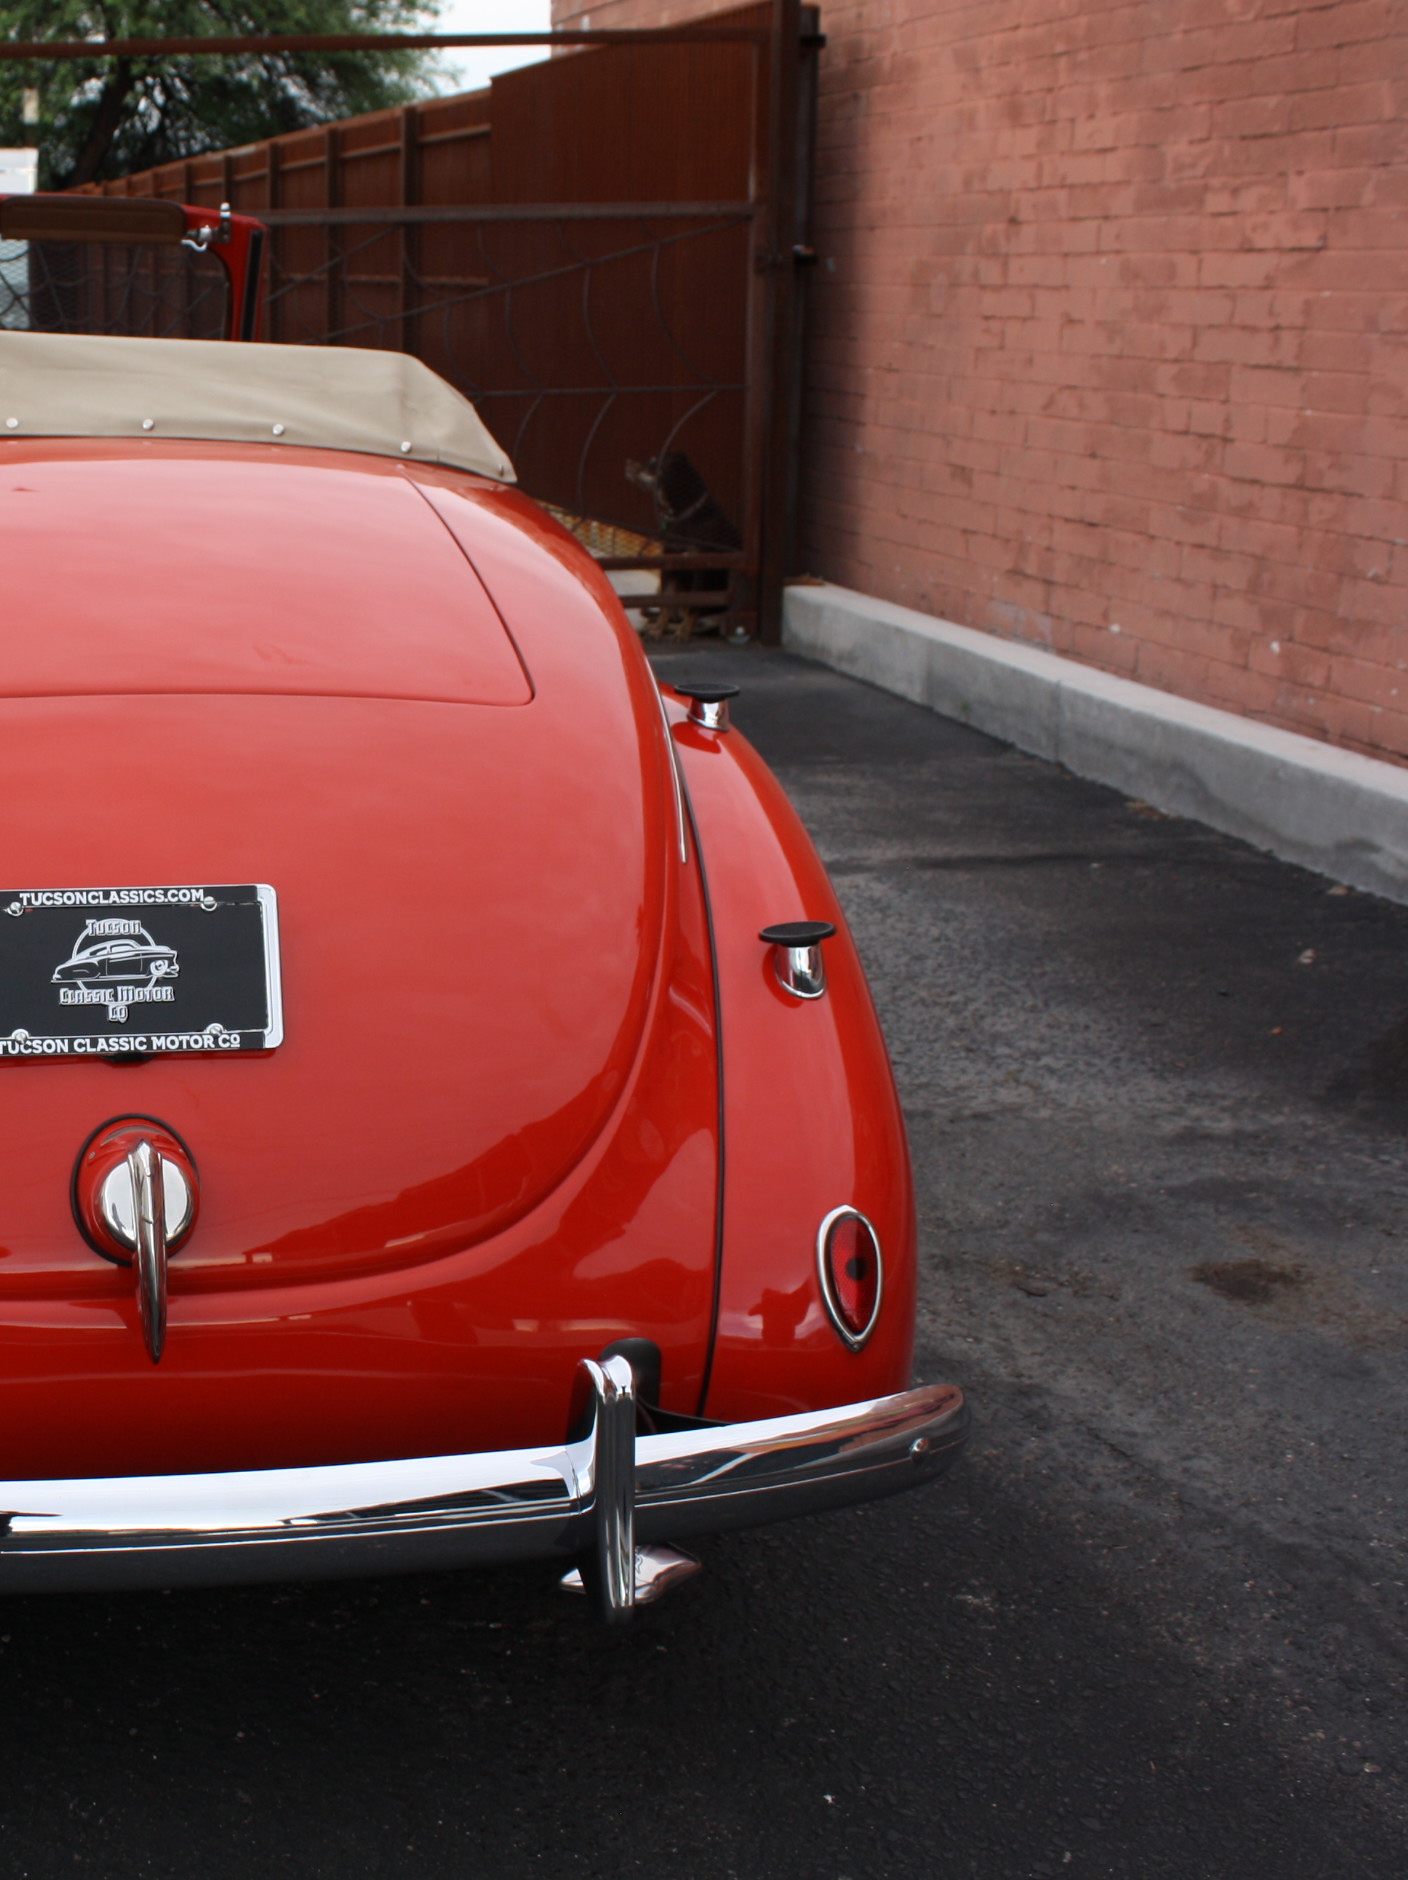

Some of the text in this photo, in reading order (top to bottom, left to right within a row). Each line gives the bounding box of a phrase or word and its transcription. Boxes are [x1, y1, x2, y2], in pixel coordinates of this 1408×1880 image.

[19, 888, 205, 906] TUCSONCLASSICS.COM
[73, 1036, 147, 1053] CLASSIC
[152, 1035, 215, 1050] MOTOR
